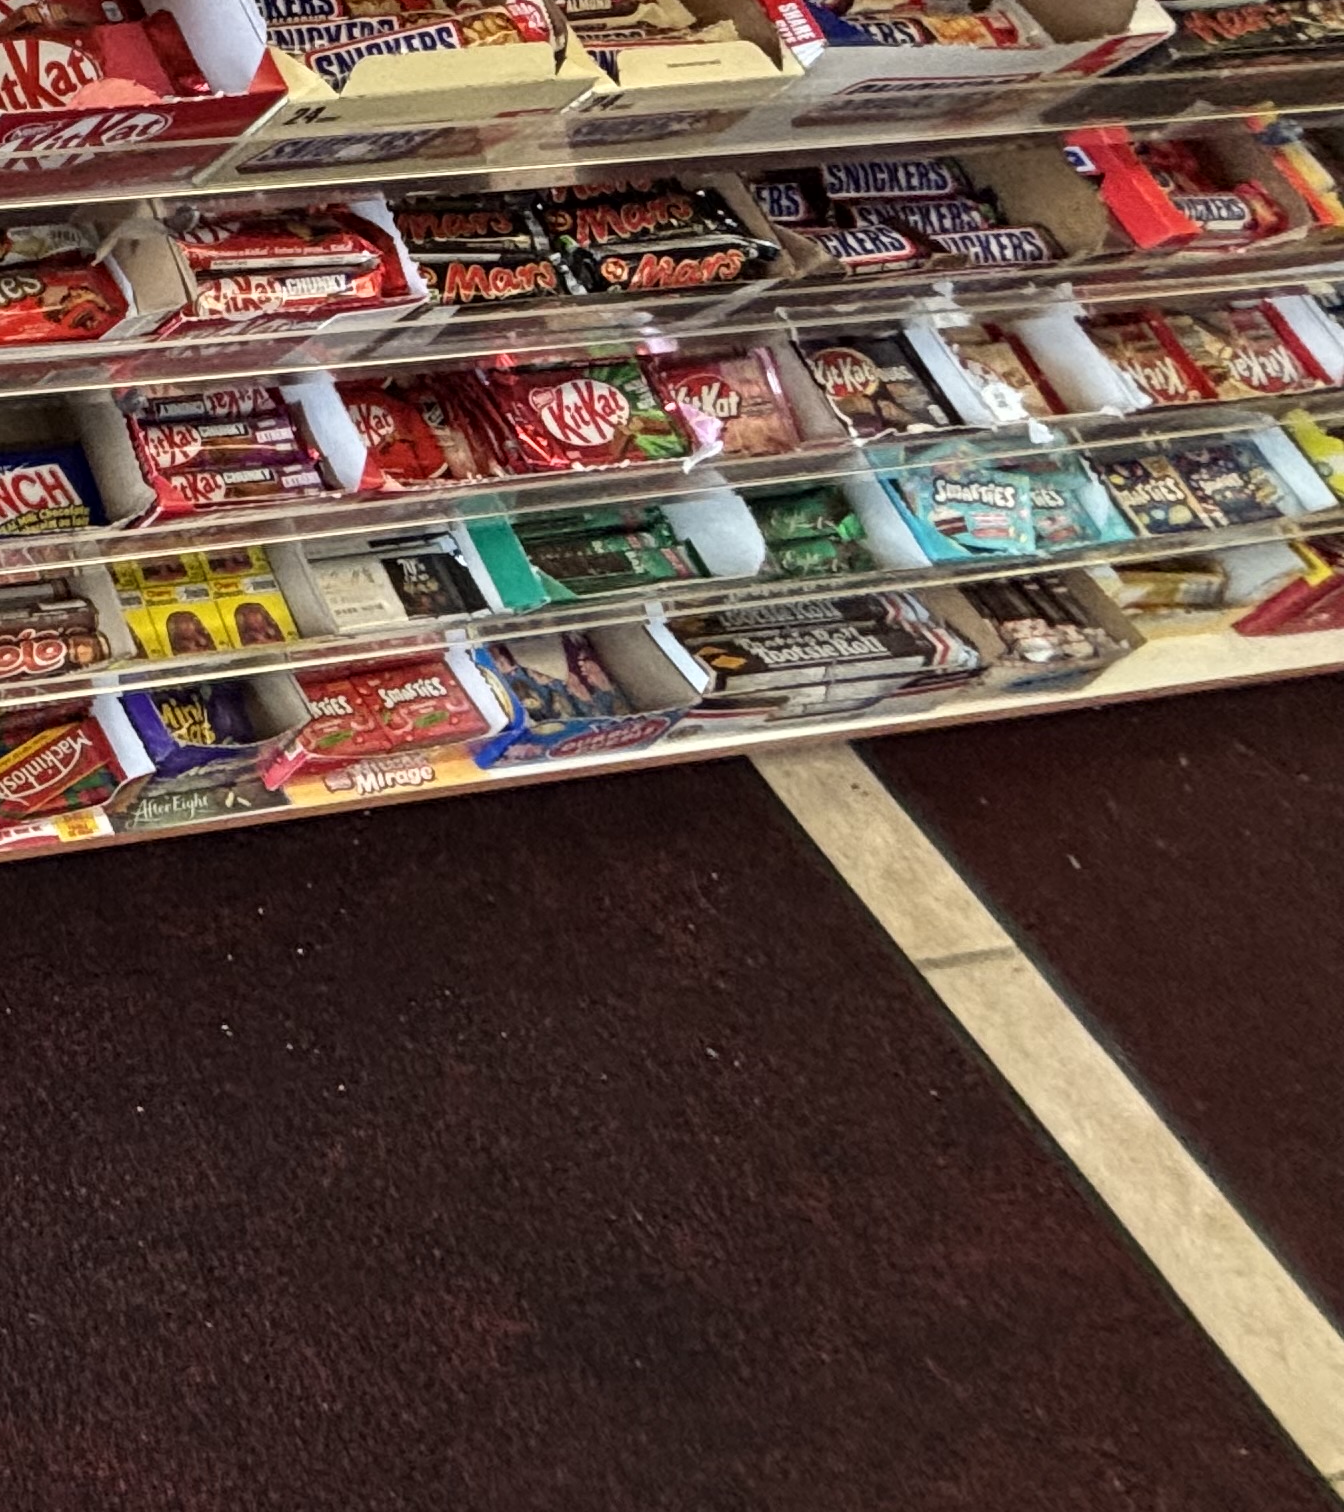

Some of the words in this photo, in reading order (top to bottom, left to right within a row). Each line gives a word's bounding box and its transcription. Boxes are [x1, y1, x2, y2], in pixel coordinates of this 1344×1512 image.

[778, 2, 814, 40] SHARE
[283, 106, 327, 125] 24
[827, 160, 951, 196] SNICKERS
[576, 194, 696, 245] Mars
[285, 274, 347, 295] CHUNKY
[442, 261, 557, 304] Mars
[630, 249, 746, 289] Mars
[812, 353, 877, 395] KitKat
[546, 379, 629, 444] KitKat
[934, 477, 1016, 509] SMARTIES
[837, 634, 889, 656] Roll
[379, 676, 448, 710] SMARTIES
[354, 760, 438, 796] Mirage
